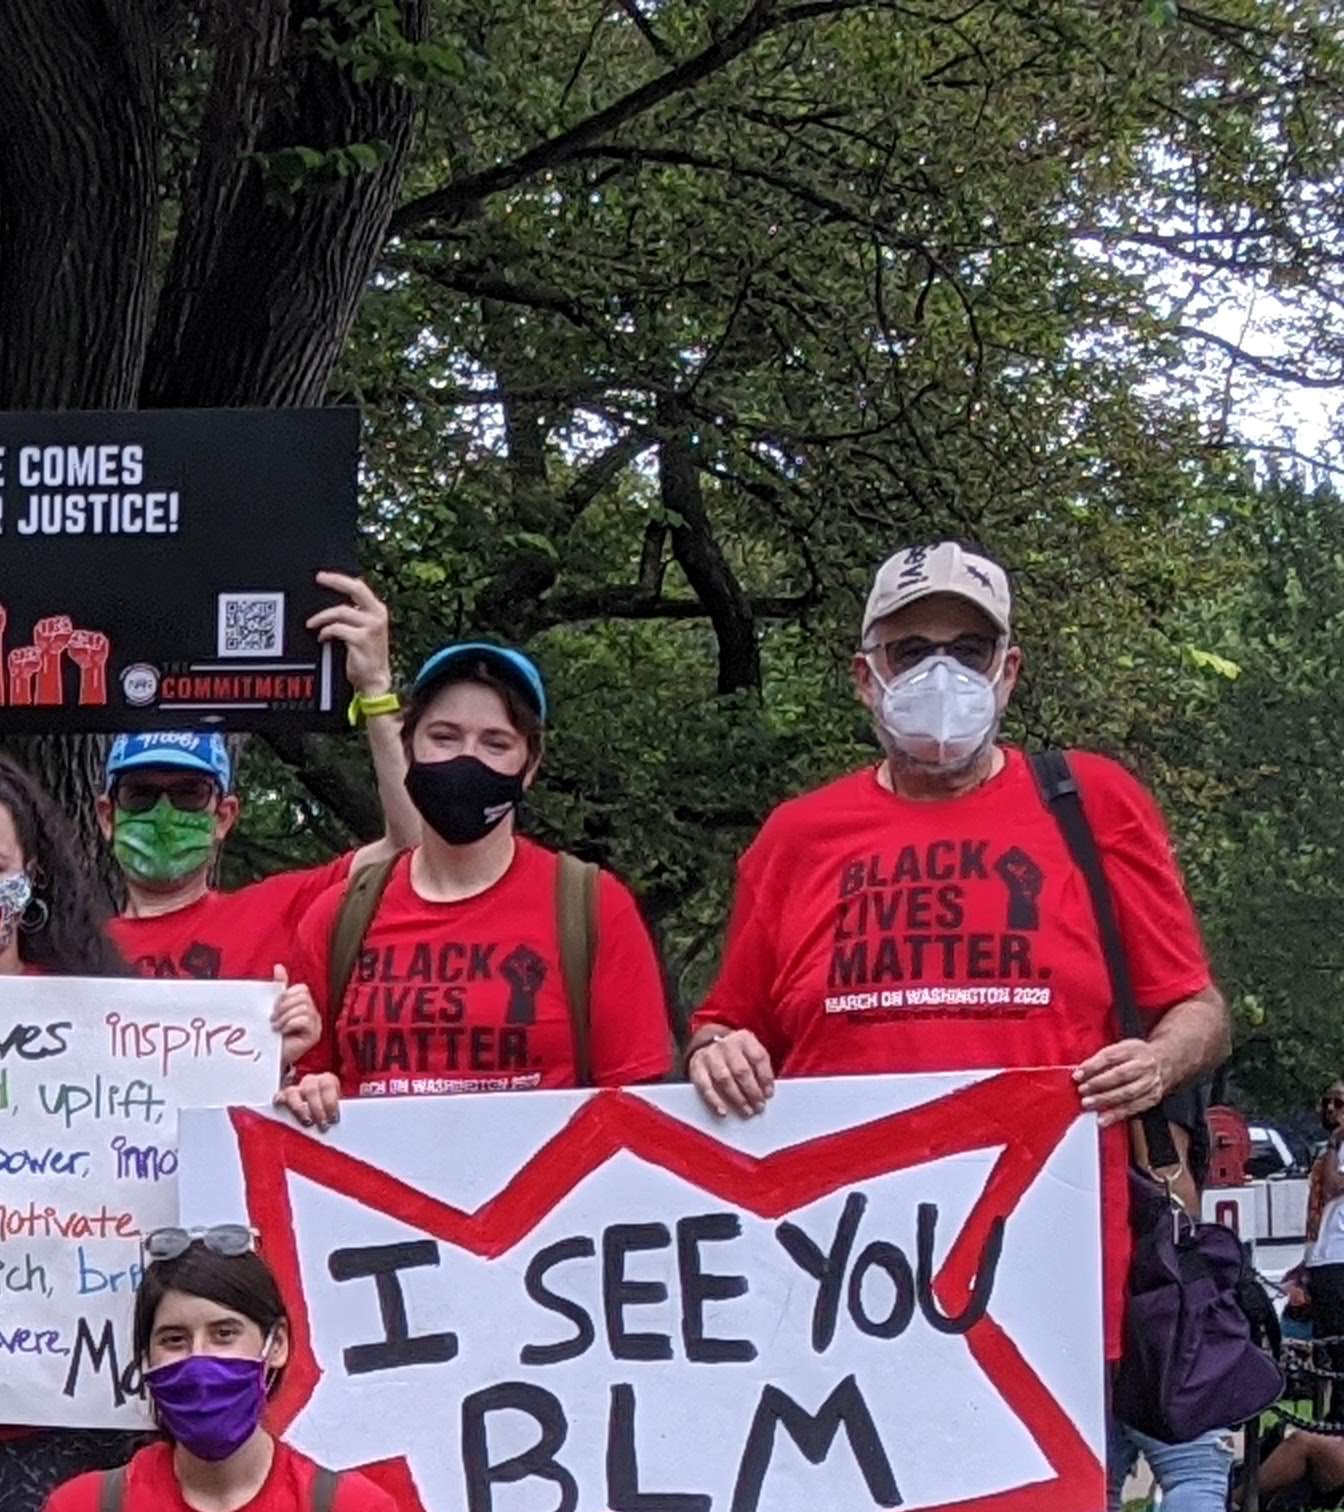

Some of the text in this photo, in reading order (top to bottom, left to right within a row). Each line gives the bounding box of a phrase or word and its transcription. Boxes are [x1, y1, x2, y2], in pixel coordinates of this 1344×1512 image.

[19, 445, 143, 487] COMES
[17, 492, 179, 534] JUSTICE!
[163, 675, 313, 698] COMMITMENT
[839, 839, 991, 898] BLACK
[834, 885, 965, 940] LIVES
[357, 942, 499, 983] BLACK
[828, 934, 1052, 988] MATTER.
[348, 986, 468, 1025] LIVES
[825, 988, 1050, 1013] MARCH ON WASHINGTON 2020
[104, 1011, 262, 1076] inspire,
[38, 1074, 166, 1128] uplift,
[411, 1077, 508, 1094] WASHINGTON
[328, 1238, 459, 1376] I
[520, 1212, 759, 1367] SEE
[775, 1191, 1005, 1356] YOU
